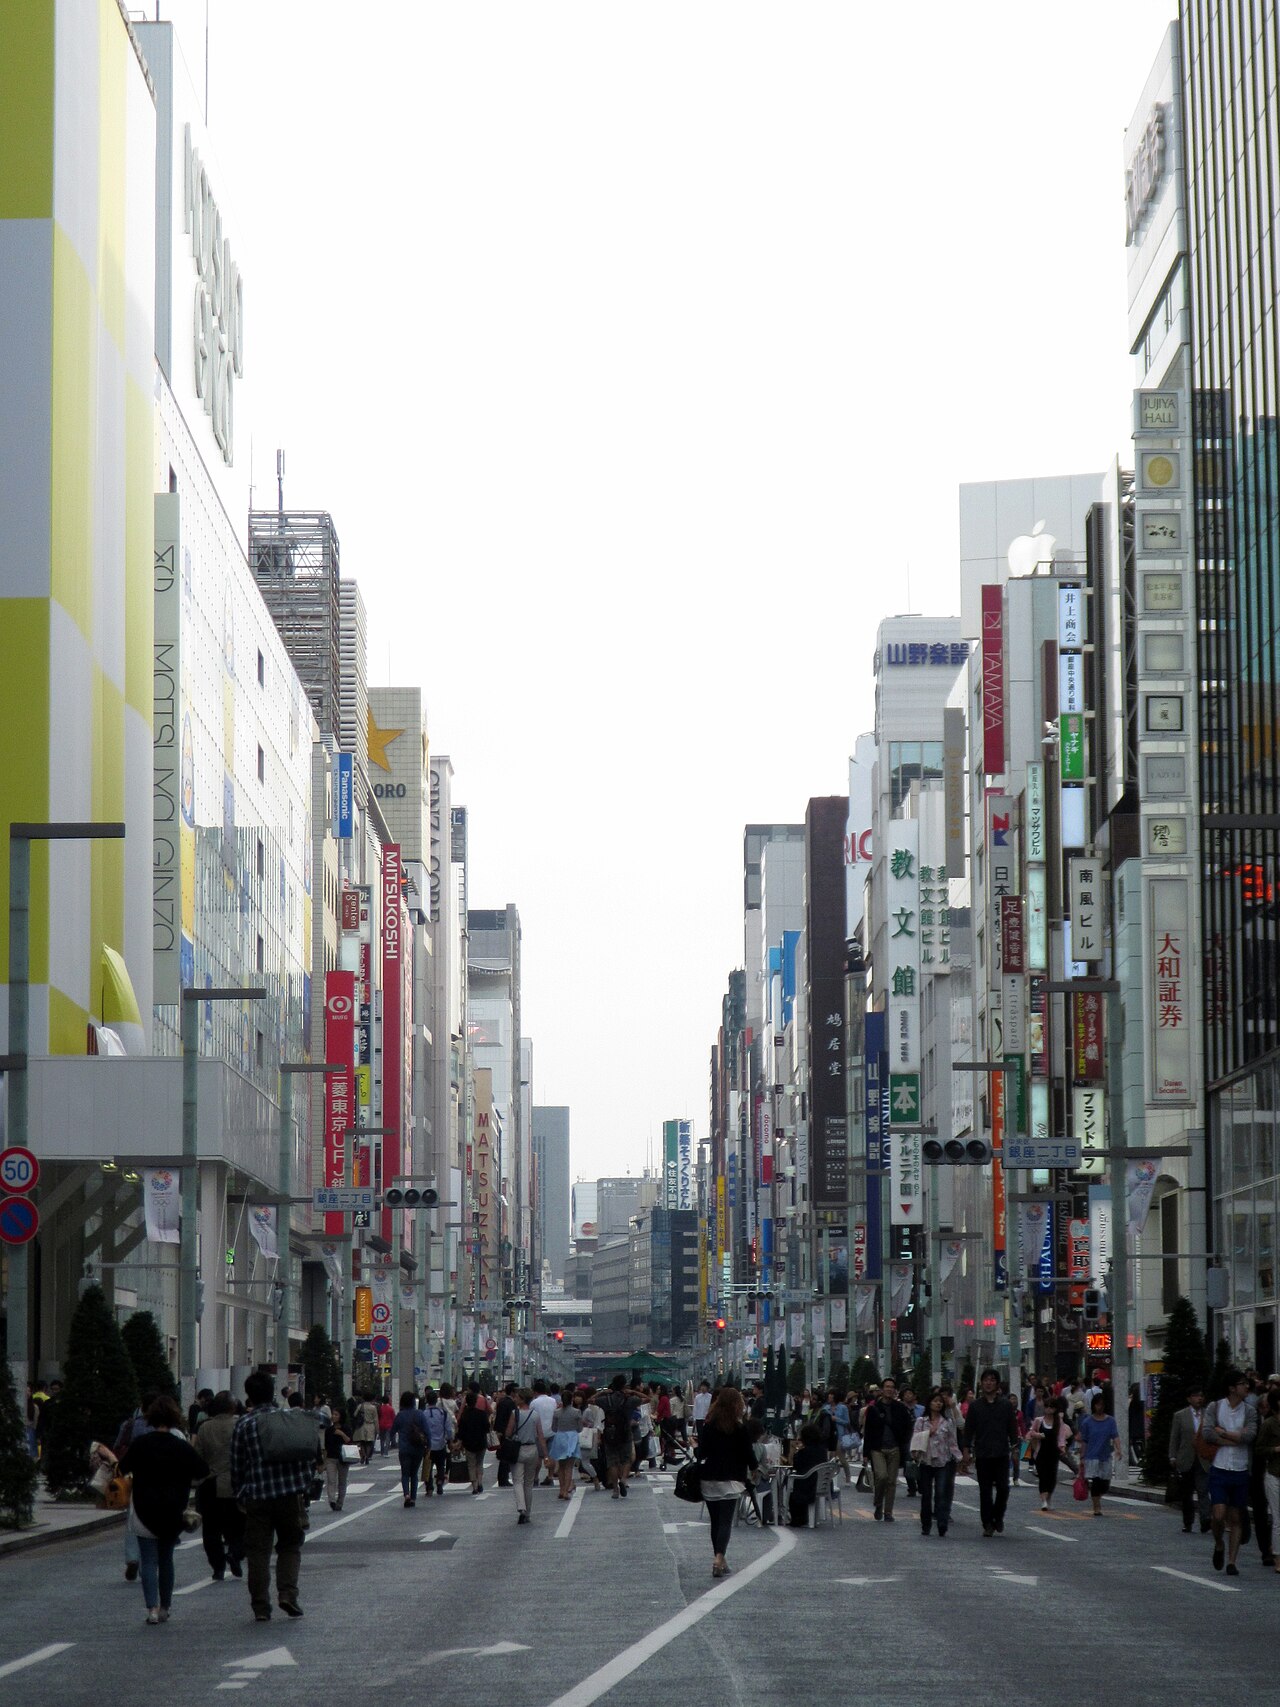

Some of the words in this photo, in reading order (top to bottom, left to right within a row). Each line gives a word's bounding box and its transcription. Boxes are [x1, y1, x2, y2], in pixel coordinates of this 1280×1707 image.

[1143, 397, 1175, 411] JUJIYA
[1145, 412, 1174, 424] HALL
[341, 770, 350, 820] Panasonic
[371, 783, 407, 798] ORO
[385, 851, 398, 959] MITSUKOSHI
[1079, 868, 1094, 950] 南風ビル
[891, 848, 915, 998] 教文館
[1157, 932, 1183, 1028] 大和証券
[893, 1081, 917, 1115] 本
[763, 1113, 771, 1144] docomo
[1008, 1146, 1077, 1158] 銀座二丁目
[4, 1160, 30, 1181] 50
[317, 1194, 371, 1204] 銀座二丁目
